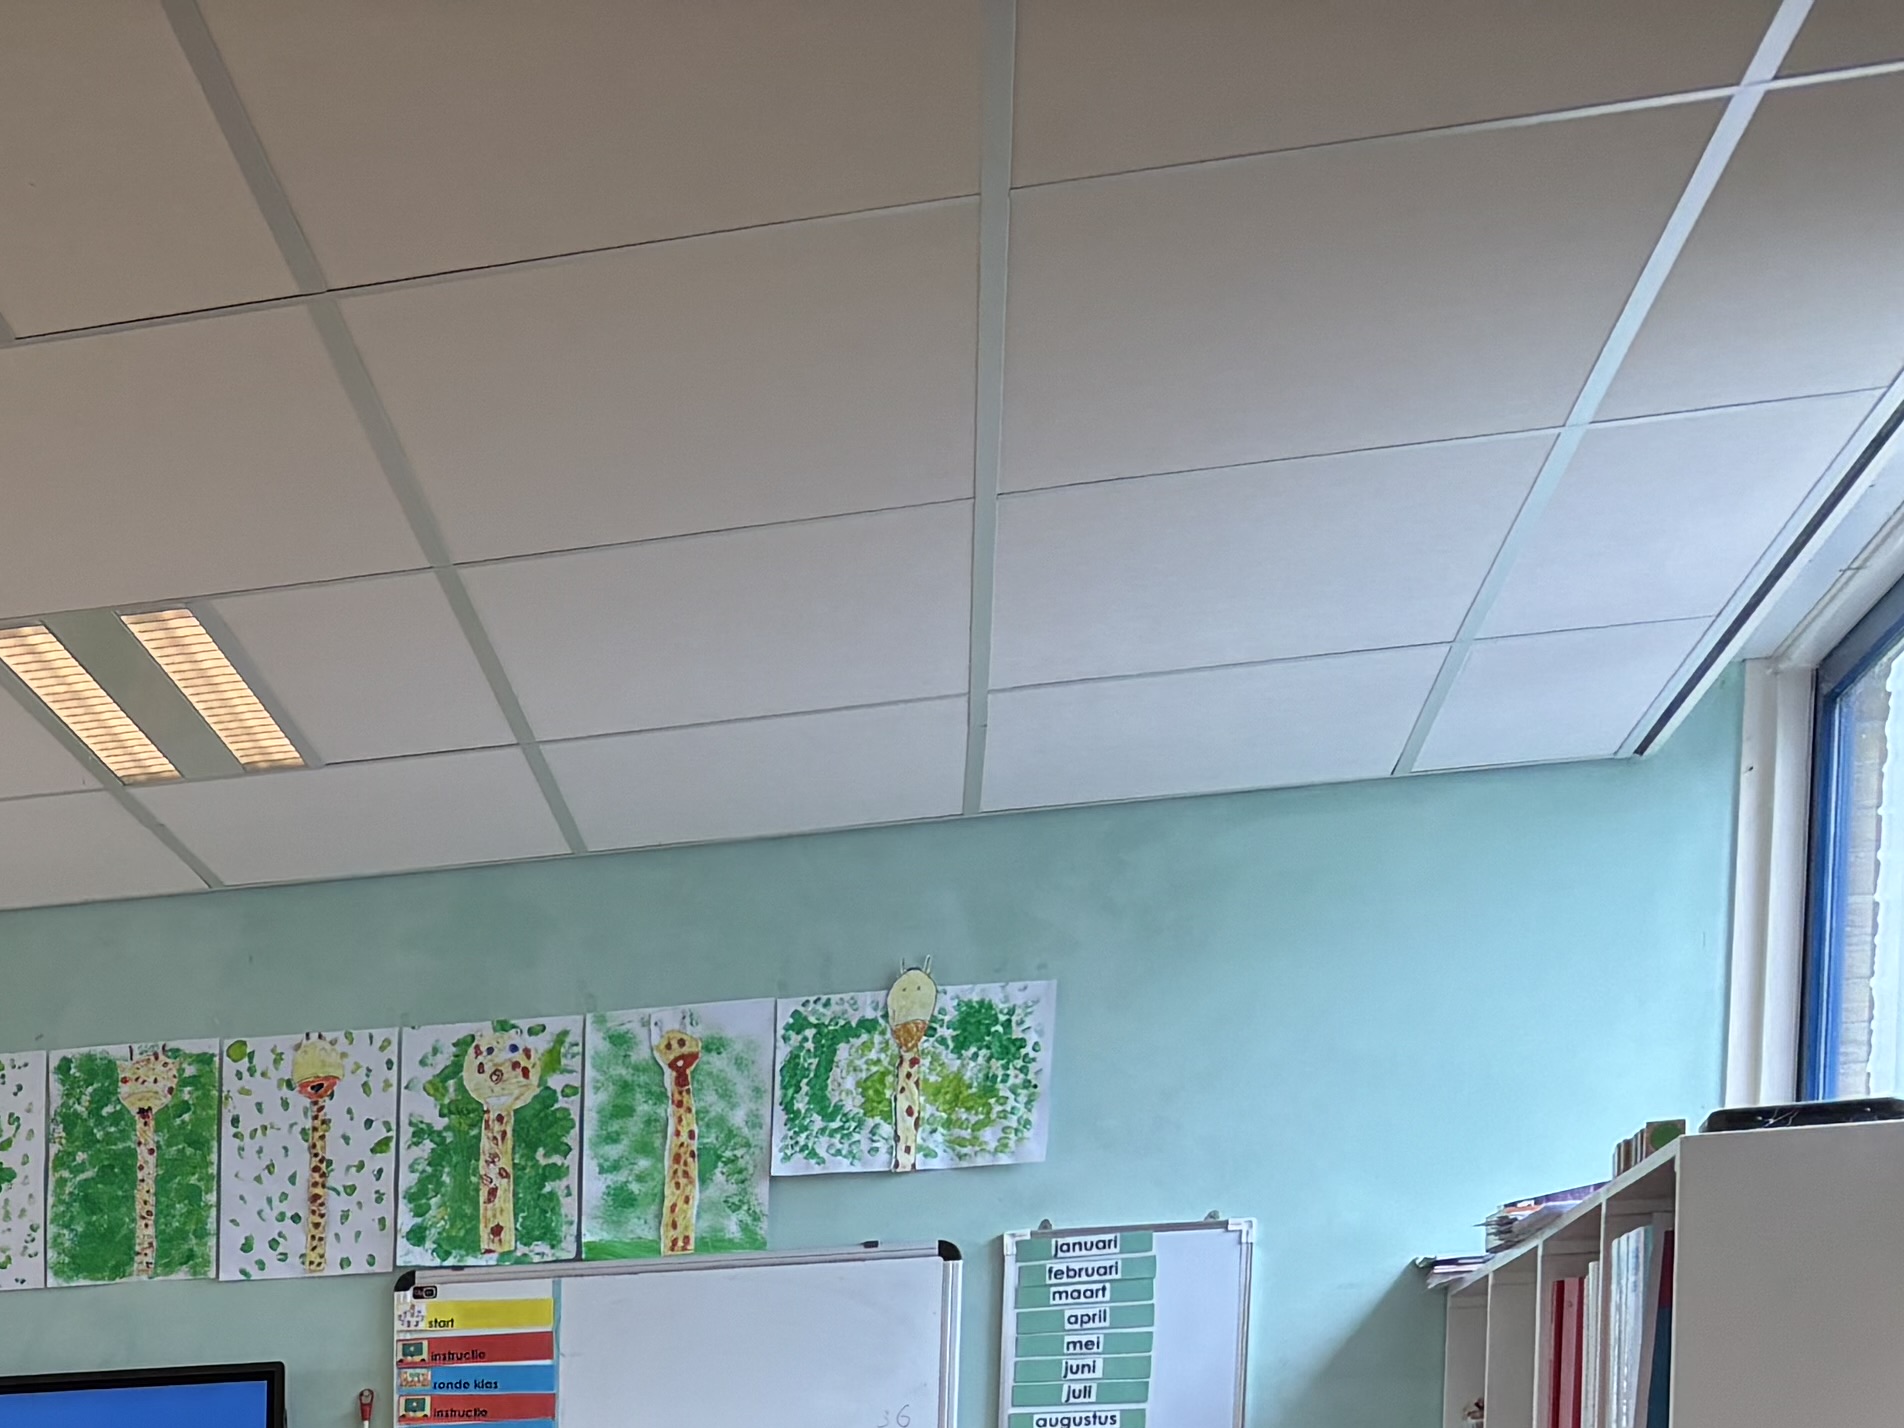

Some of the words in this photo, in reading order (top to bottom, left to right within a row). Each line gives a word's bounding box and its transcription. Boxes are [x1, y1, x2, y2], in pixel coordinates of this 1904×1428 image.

[1054, 1235, 1118, 1258] januari
[1047, 1261, 1119, 1280] februari
[1052, 1284, 1107, 1302] maart
[428, 1318, 454, 1329] start
[1066, 1308, 1107, 1328] april
[1066, 1336, 1101, 1352] mei
[1062, 1359, 1096, 1379] juni
[474, 1379, 498, 1389] klas
[1064, 1385, 1092, 1403] juli
